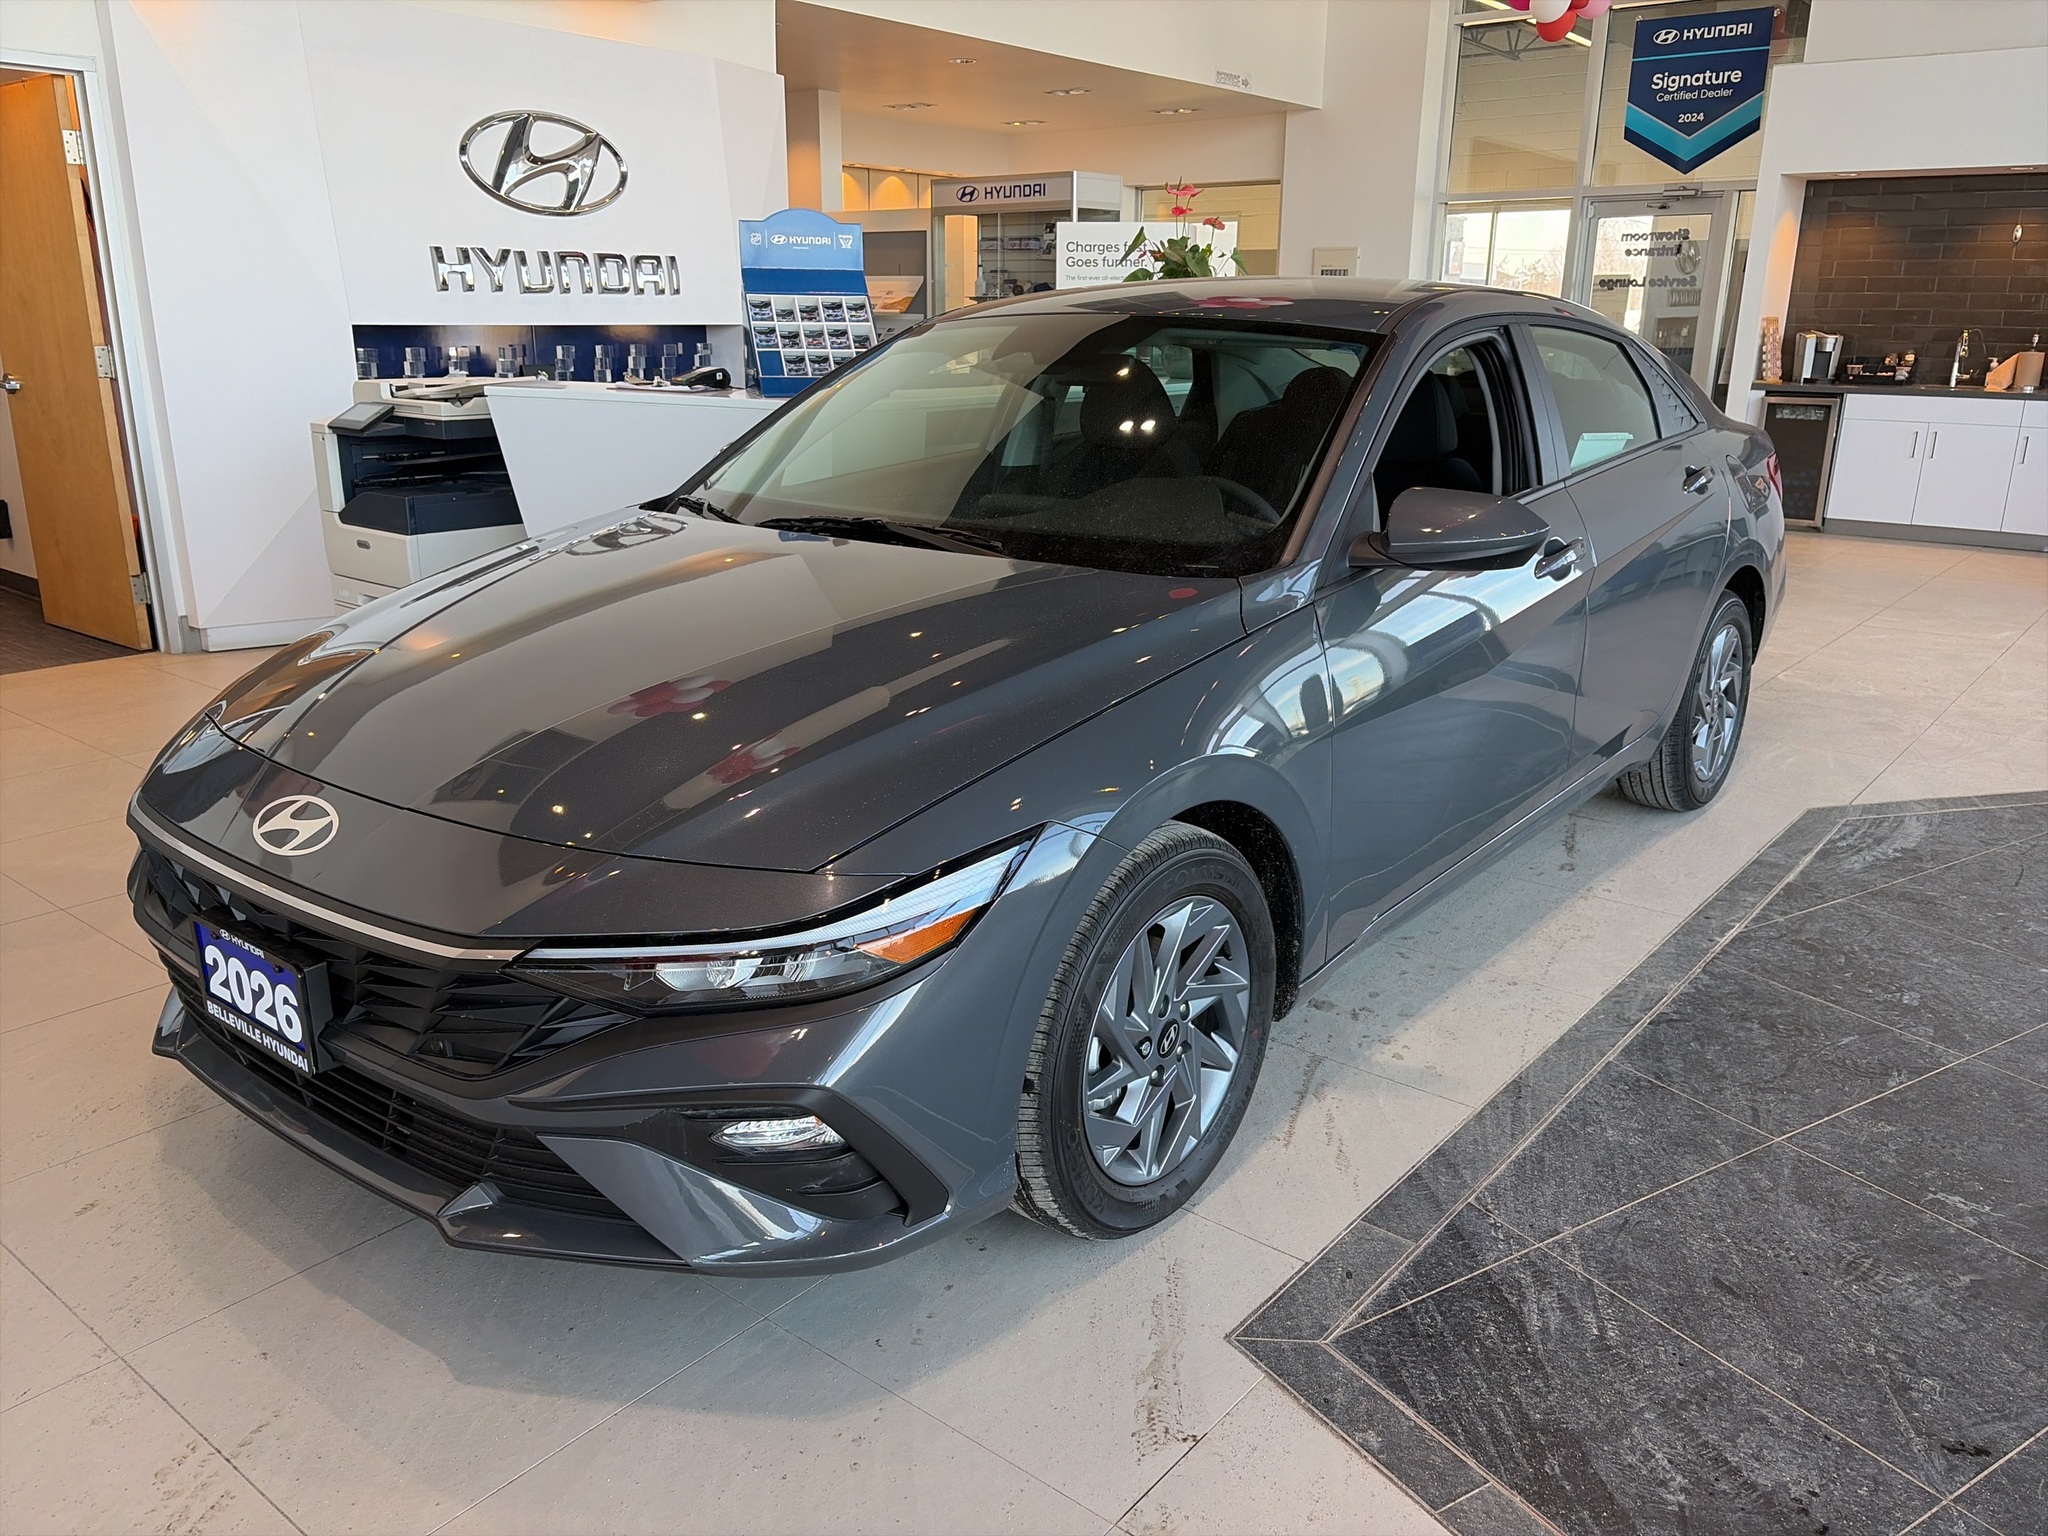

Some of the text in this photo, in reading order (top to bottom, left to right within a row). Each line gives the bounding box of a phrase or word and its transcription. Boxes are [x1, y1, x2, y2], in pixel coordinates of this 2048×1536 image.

[1682, 22, 1753, 41] HYUNDAI
[1651, 69, 1742, 92] Signature
[1656, 87, 1734, 102] Certified Dealer
[1677, 112, 1705, 123] 2024
[984, 182, 1047, 200] HYUNDAI
[789, 236, 831, 245] HYUNDAI
[1066, 241, 1148, 255] Charges fst
[429, 246, 681, 296] HYUNDAI
[1066, 256, 1098, 268] Goes
[231, 934, 265, 959] HYUNDAI
[204, 944, 303, 1043] 2026
[206, 999, 309, 1073] BELLEVILLE HYUNDAI
